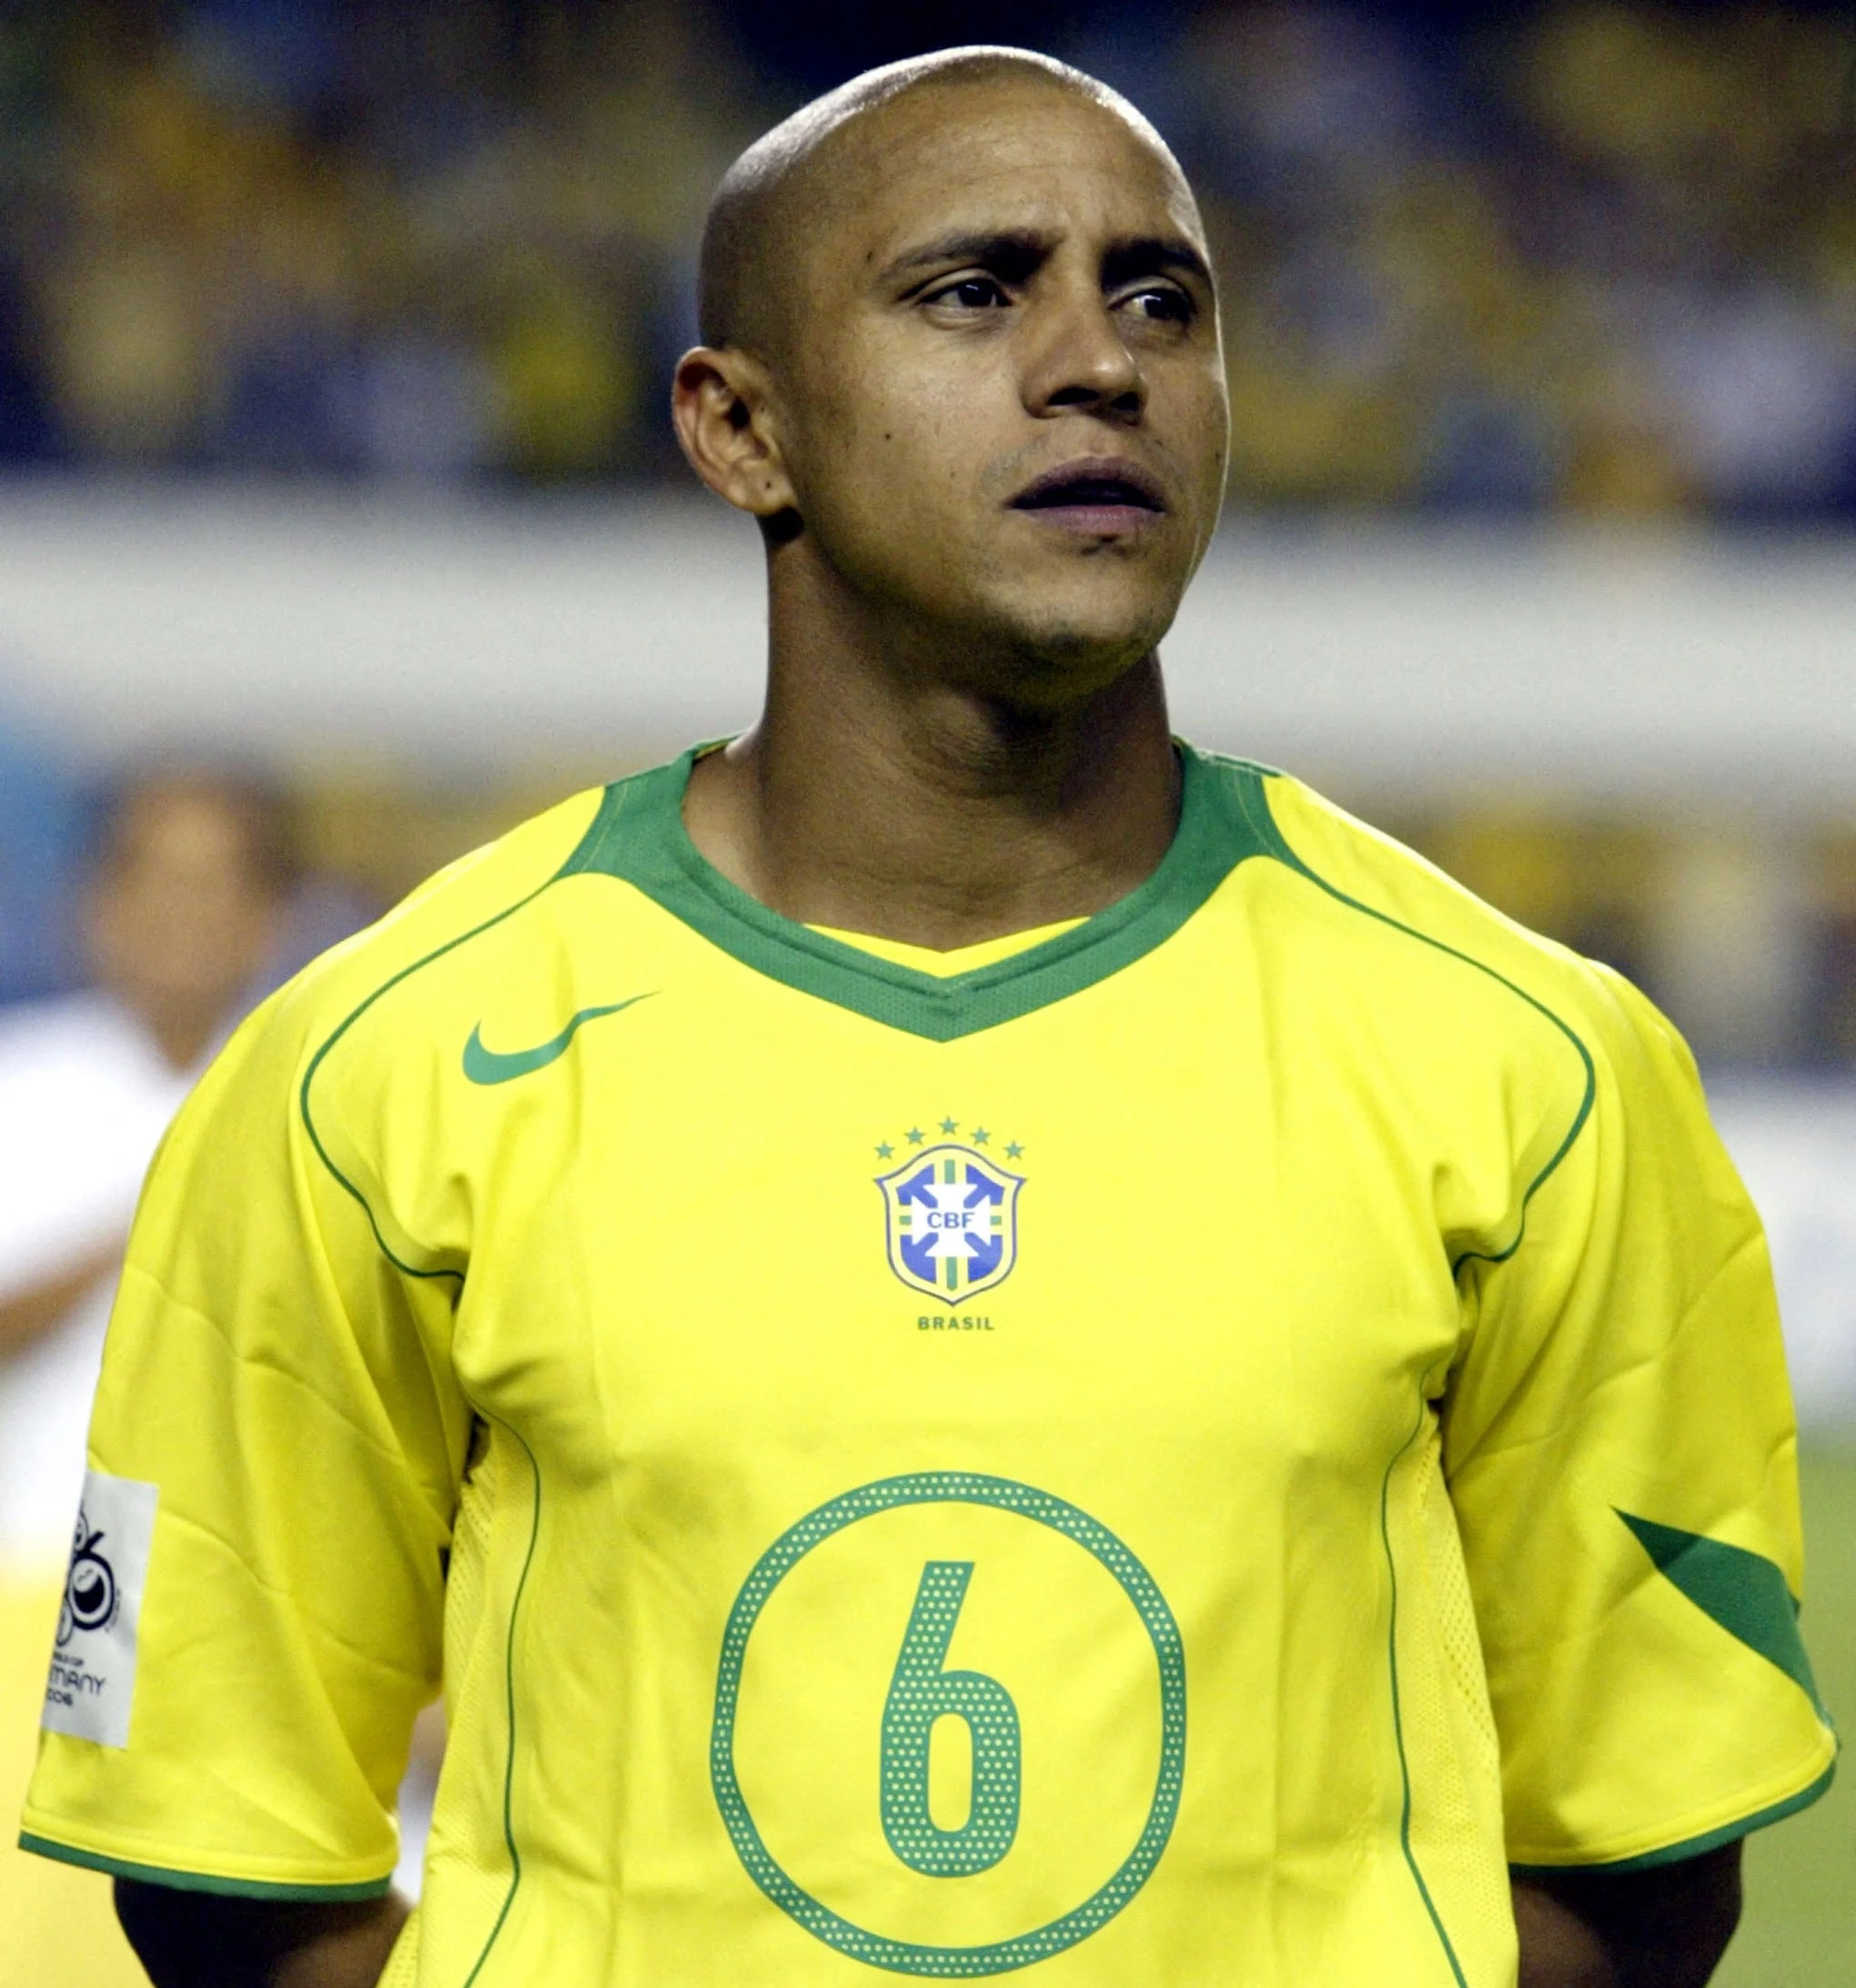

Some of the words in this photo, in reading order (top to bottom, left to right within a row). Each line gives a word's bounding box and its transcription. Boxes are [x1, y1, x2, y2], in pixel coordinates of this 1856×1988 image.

[926, 1211, 975, 1229] CBF
[917, 1316, 995, 1331] BRASIL
[879, 1560, 1022, 1879] 6
